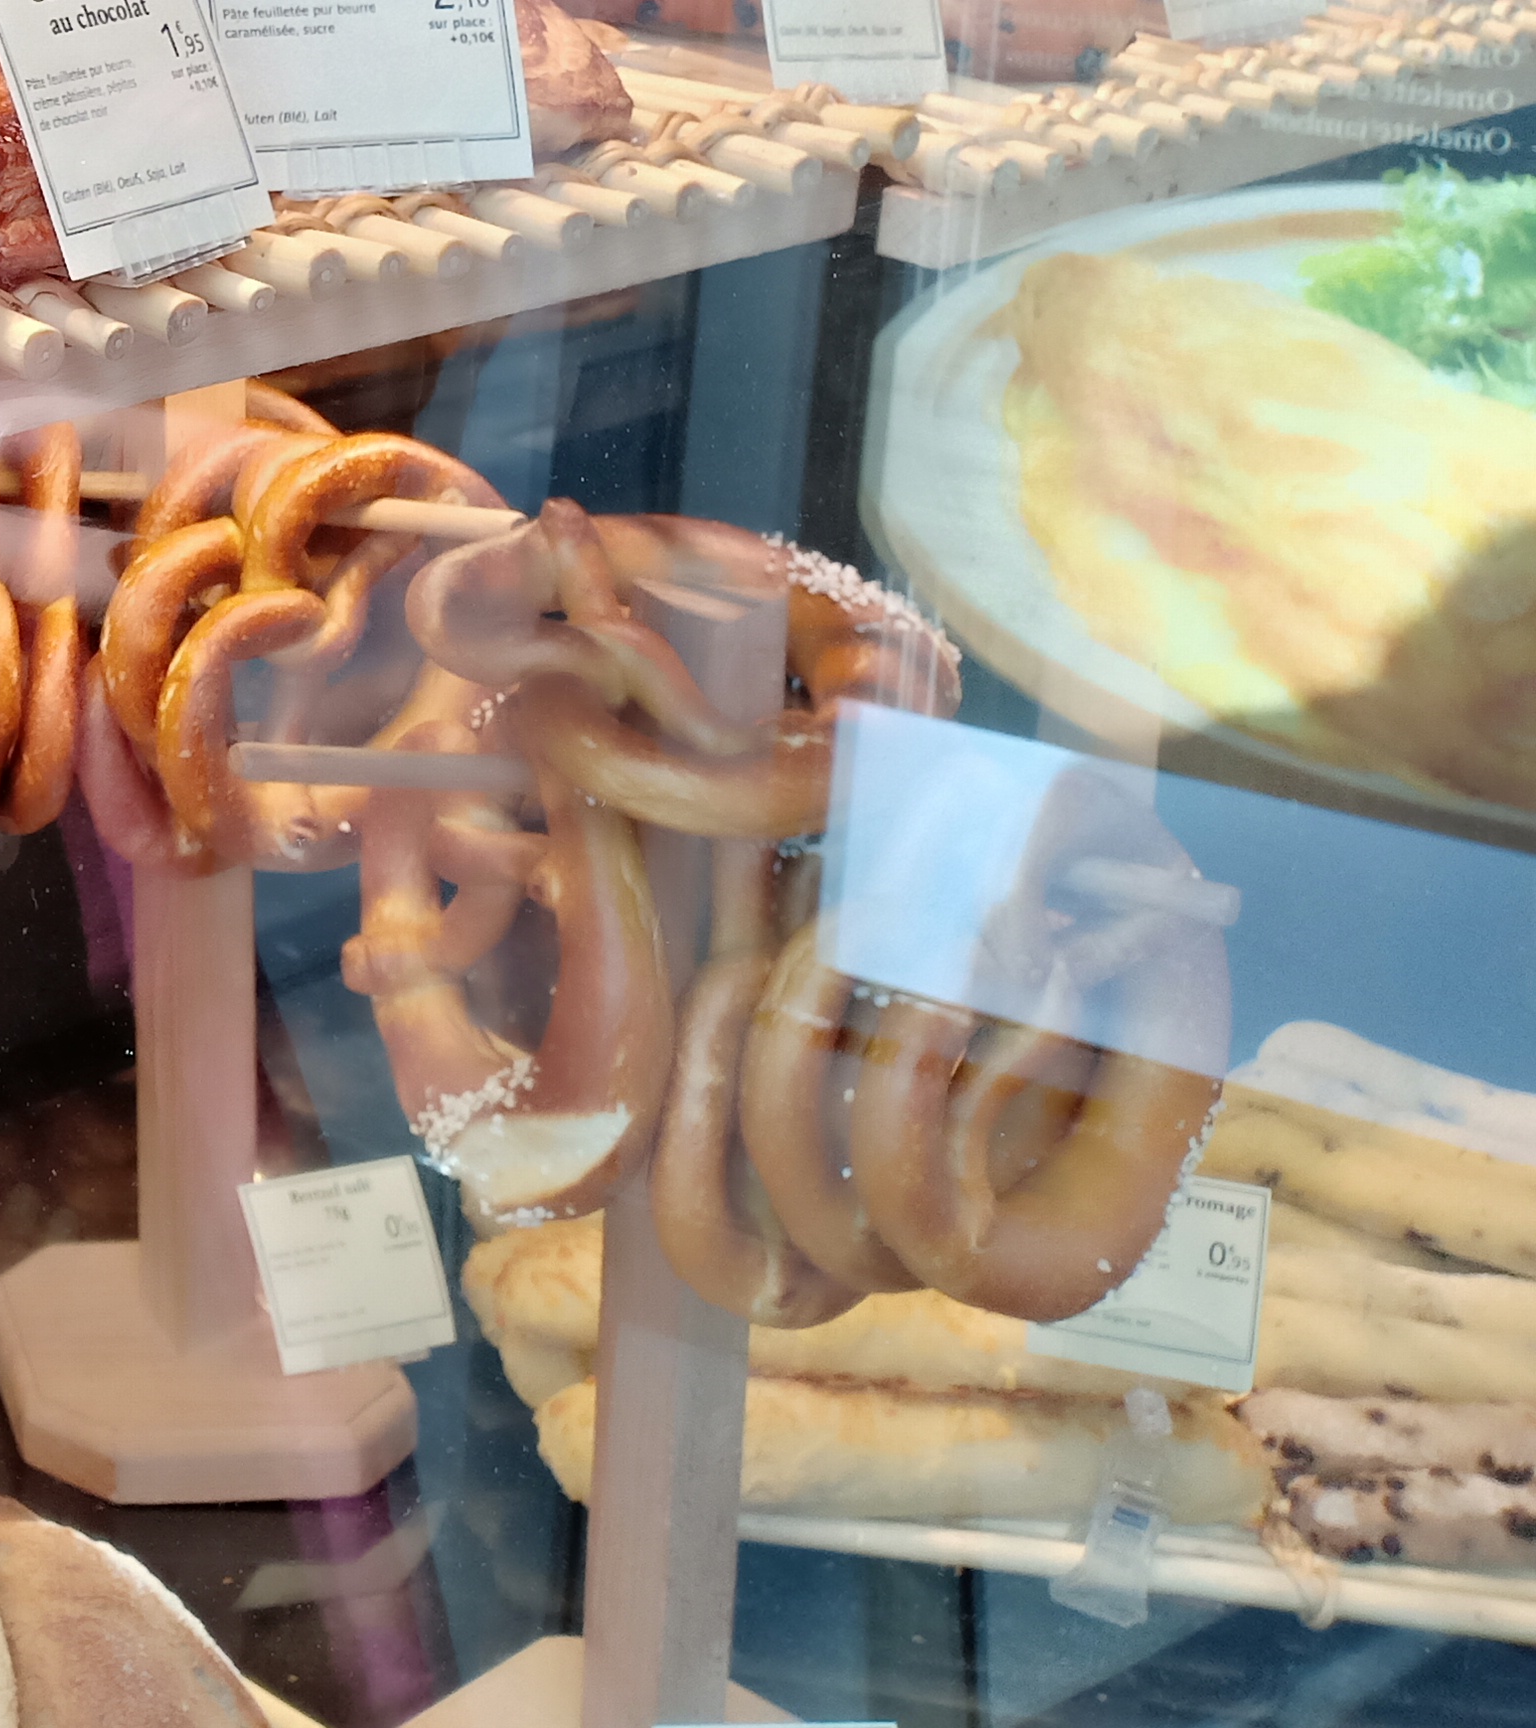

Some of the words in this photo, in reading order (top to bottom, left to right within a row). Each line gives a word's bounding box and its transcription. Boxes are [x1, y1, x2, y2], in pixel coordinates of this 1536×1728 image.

[49, 16, 74, 36] au
[244, 113, 275, 125] uten
[1186, 1196, 1255, 1221] romage
